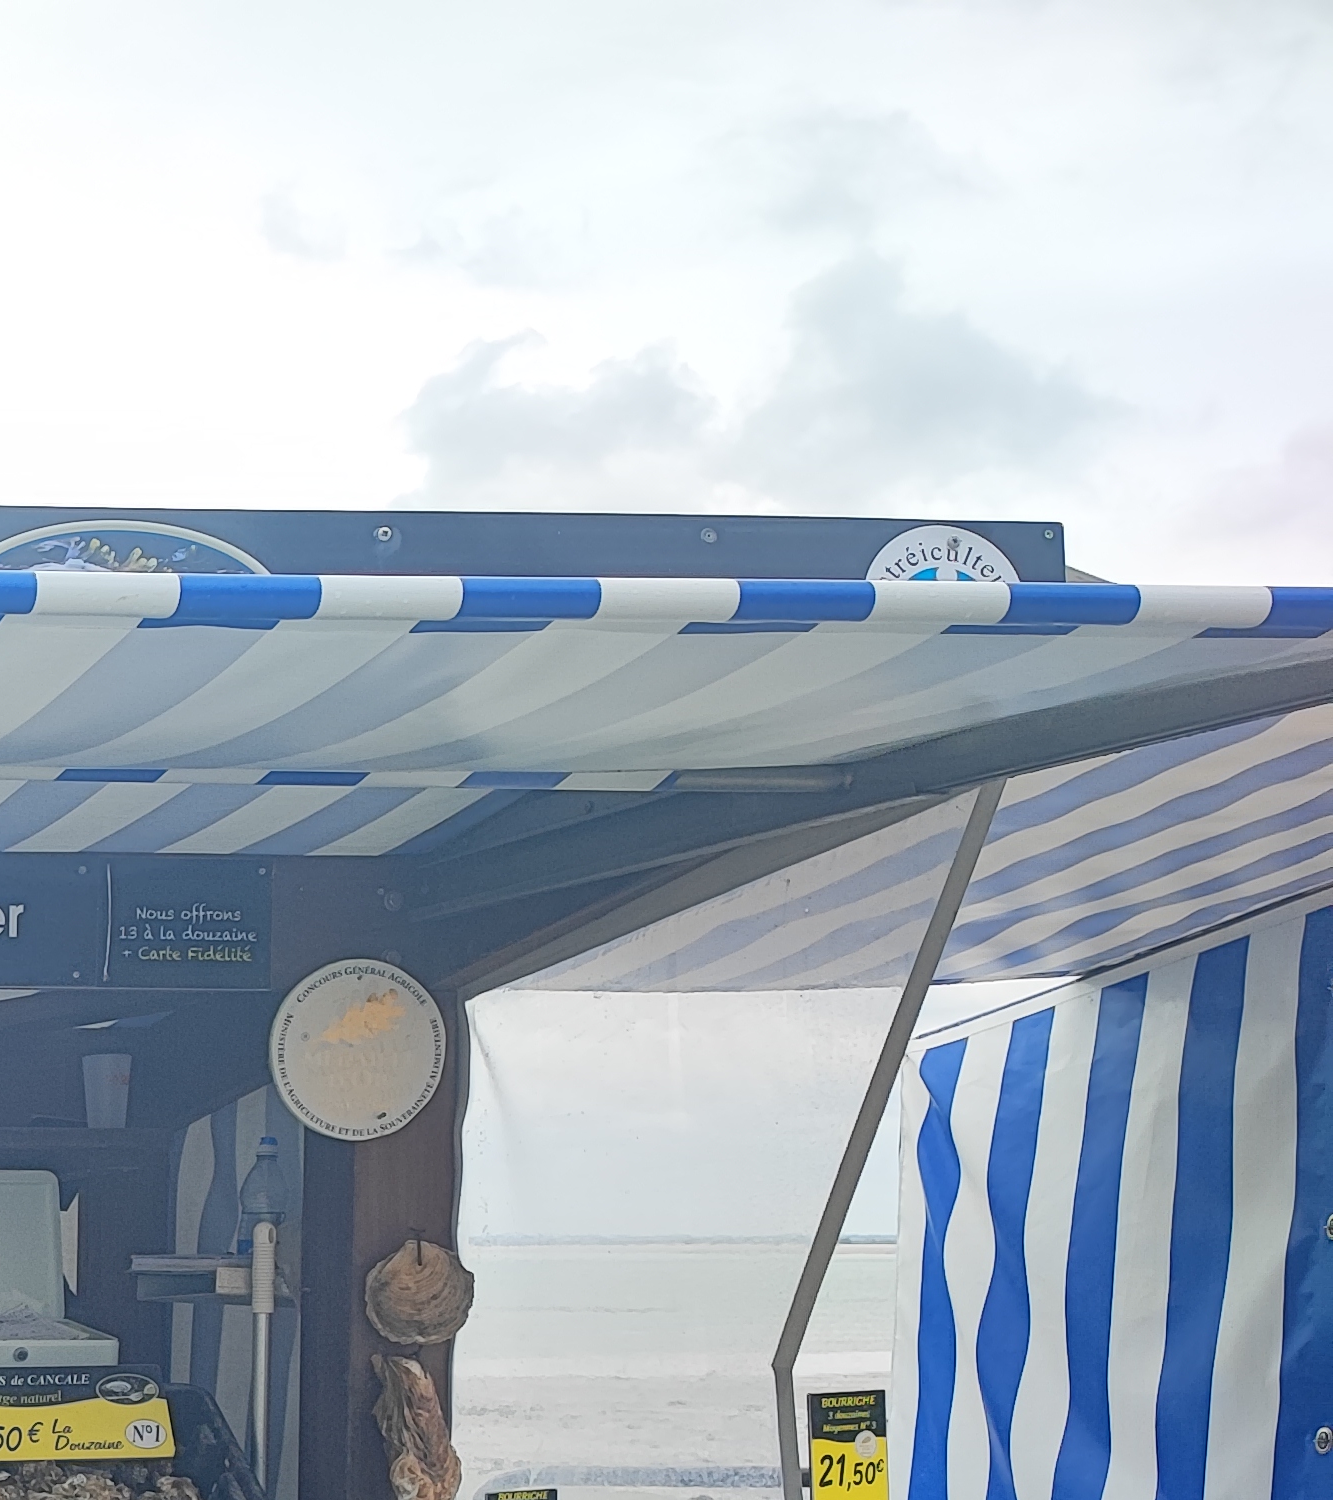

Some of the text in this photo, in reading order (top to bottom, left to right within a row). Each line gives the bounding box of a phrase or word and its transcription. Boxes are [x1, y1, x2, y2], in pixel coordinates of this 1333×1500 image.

[136, 903, 241, 925] Nous offrons
[119, 925, 257, 942] 13 à la douzaine
[138, 944, 253, 962] Carte Fidélité
[296, 968, 344, 1003] CONCOURS
[387, 971, 429, 1007] AGRICOLE
[11, 1375, 24, 1385] de
[27, 1374, 90, 1385] CANCALE
[821, 1395, 876, 1408] BOURRICHE
